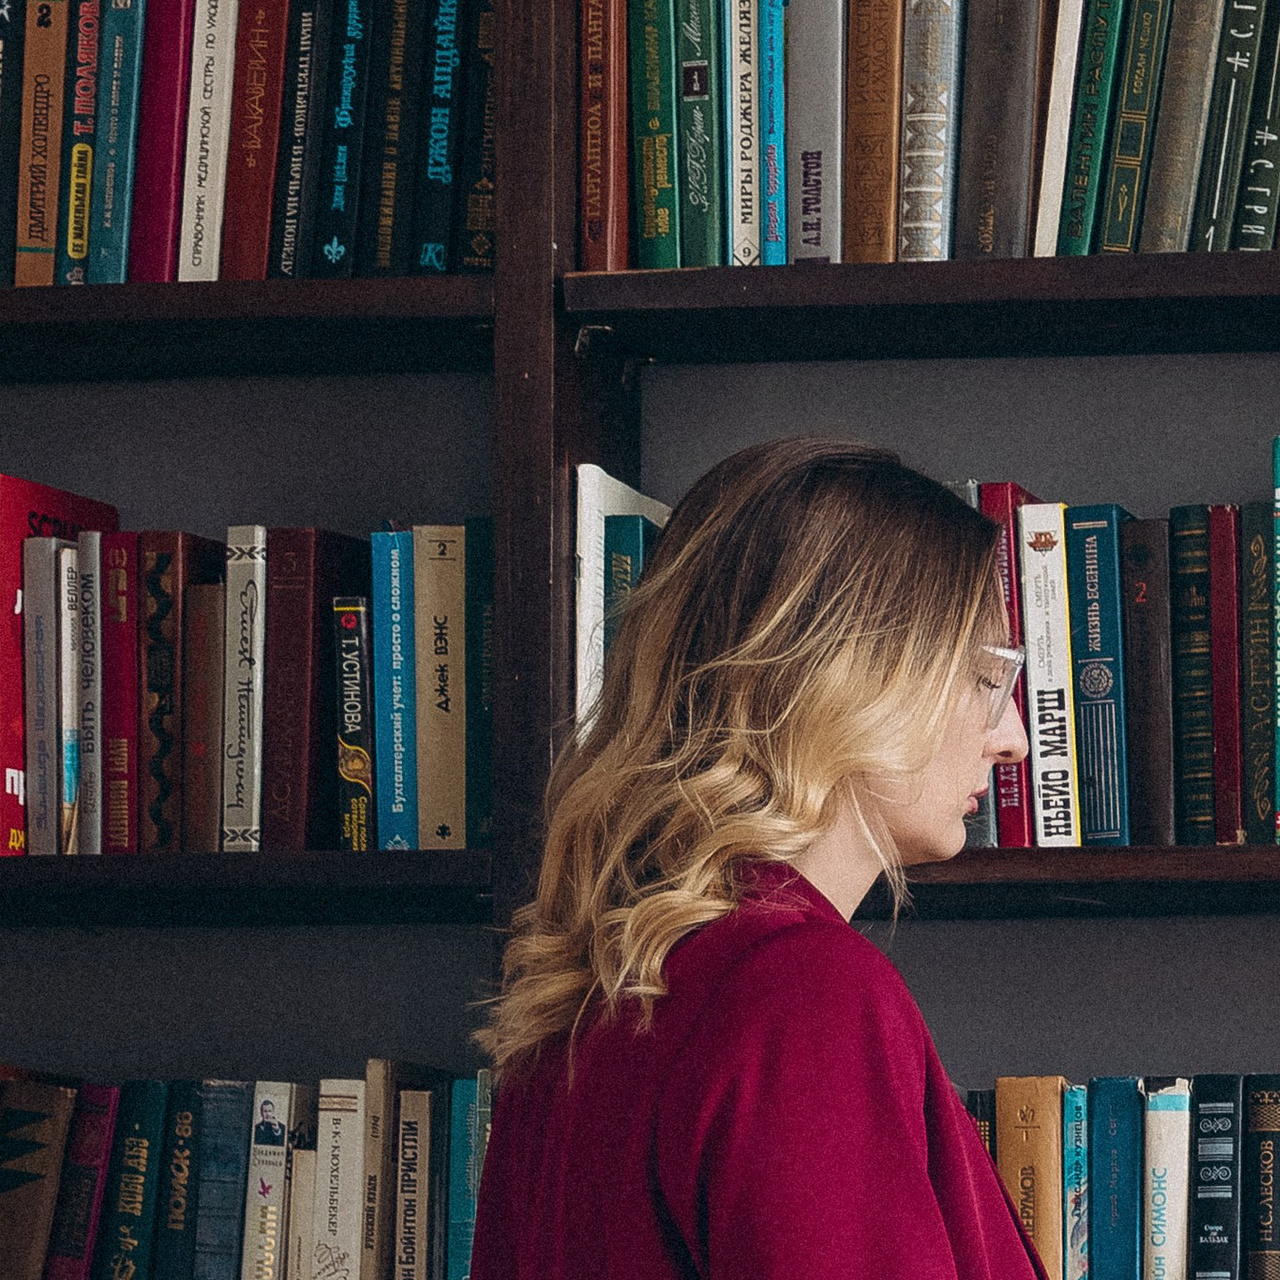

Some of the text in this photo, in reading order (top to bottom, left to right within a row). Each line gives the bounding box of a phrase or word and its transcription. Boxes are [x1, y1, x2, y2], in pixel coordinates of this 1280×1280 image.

[300, 12, 313, 50] ИВАН
[29, 74, 50, 241] ДМИТРИЙ ХОЛЕНДРО
[74, 149, 88, 179] ТАЙНА
[192, 33, 215, 266] СПРАВОЧНИК МЕДИЦИНСКОЙ СЕСТРЫ ПО
[427, 107, 452, 184] ДЖОН
[586, 74, 602, 218] ГАРГАНТЮА И
[740, 72, 755, 224] МИРЫ РОДЖЕРА
[801, 151, 821, 215] ТОЛСТОЙ
[1065, 103, 1095, 238] ВАЛЕНТИН
[73, 182, 87, 240] МАЛЕНЬКАЯ
[286, 196, 301, 216] НА
[281, 219, 299, 275] ПОБЕДУ
[66, 566, 78, 611] ВЕЛЛЕР
[389, 548, 401, 611] сложном
[1084, 535, 1102, 652] ЖИЗНЬ ЕСЕНИНА
[391, 624, 404, 670] просто
[434, 615, 452, 714] Джек ВЭНС
[79, 700, 95, 754] БЫТЬ
[343, 651, 361, 733] УСТИНОВА
[391, 712, 405, 814] Бухгалтерский
[1036, 688, 1072, 838] НЬЕЙО МАРШ
[400, 1120, 419, 1194] ПРИСТЛИ
[399, 1199, 417, 1265] Бойнтон
[1150, 1168, 1167, 1247] СИМОНС
